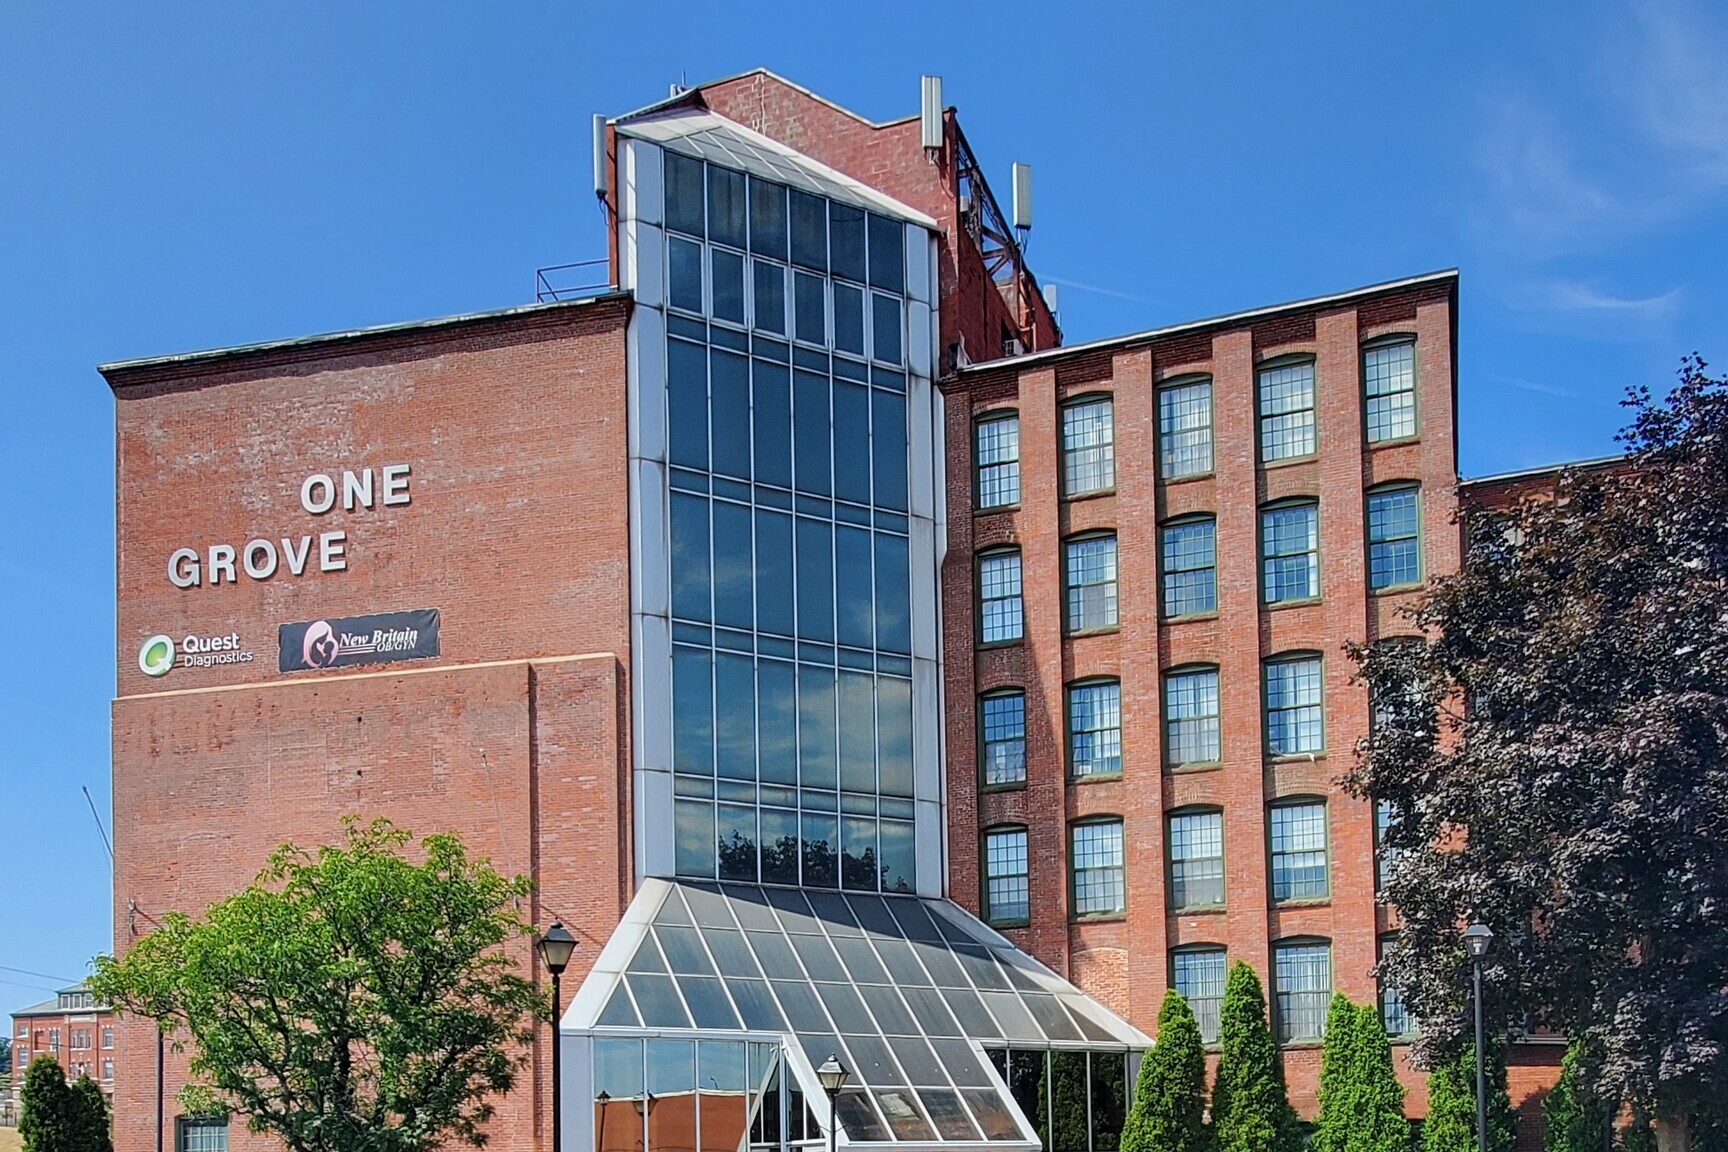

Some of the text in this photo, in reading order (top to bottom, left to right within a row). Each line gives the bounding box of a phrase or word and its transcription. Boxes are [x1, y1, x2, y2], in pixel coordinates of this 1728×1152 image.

[301, 464, 411, 514] ONE
[168, 531, 347, 588] GROVE
[183, 633, 240, 653] Quest
[340, 627, 418, 647] New Britain
[377, 640, 416, 652] OB/GYN
[184, 651, 253, 667] Diagnostics
